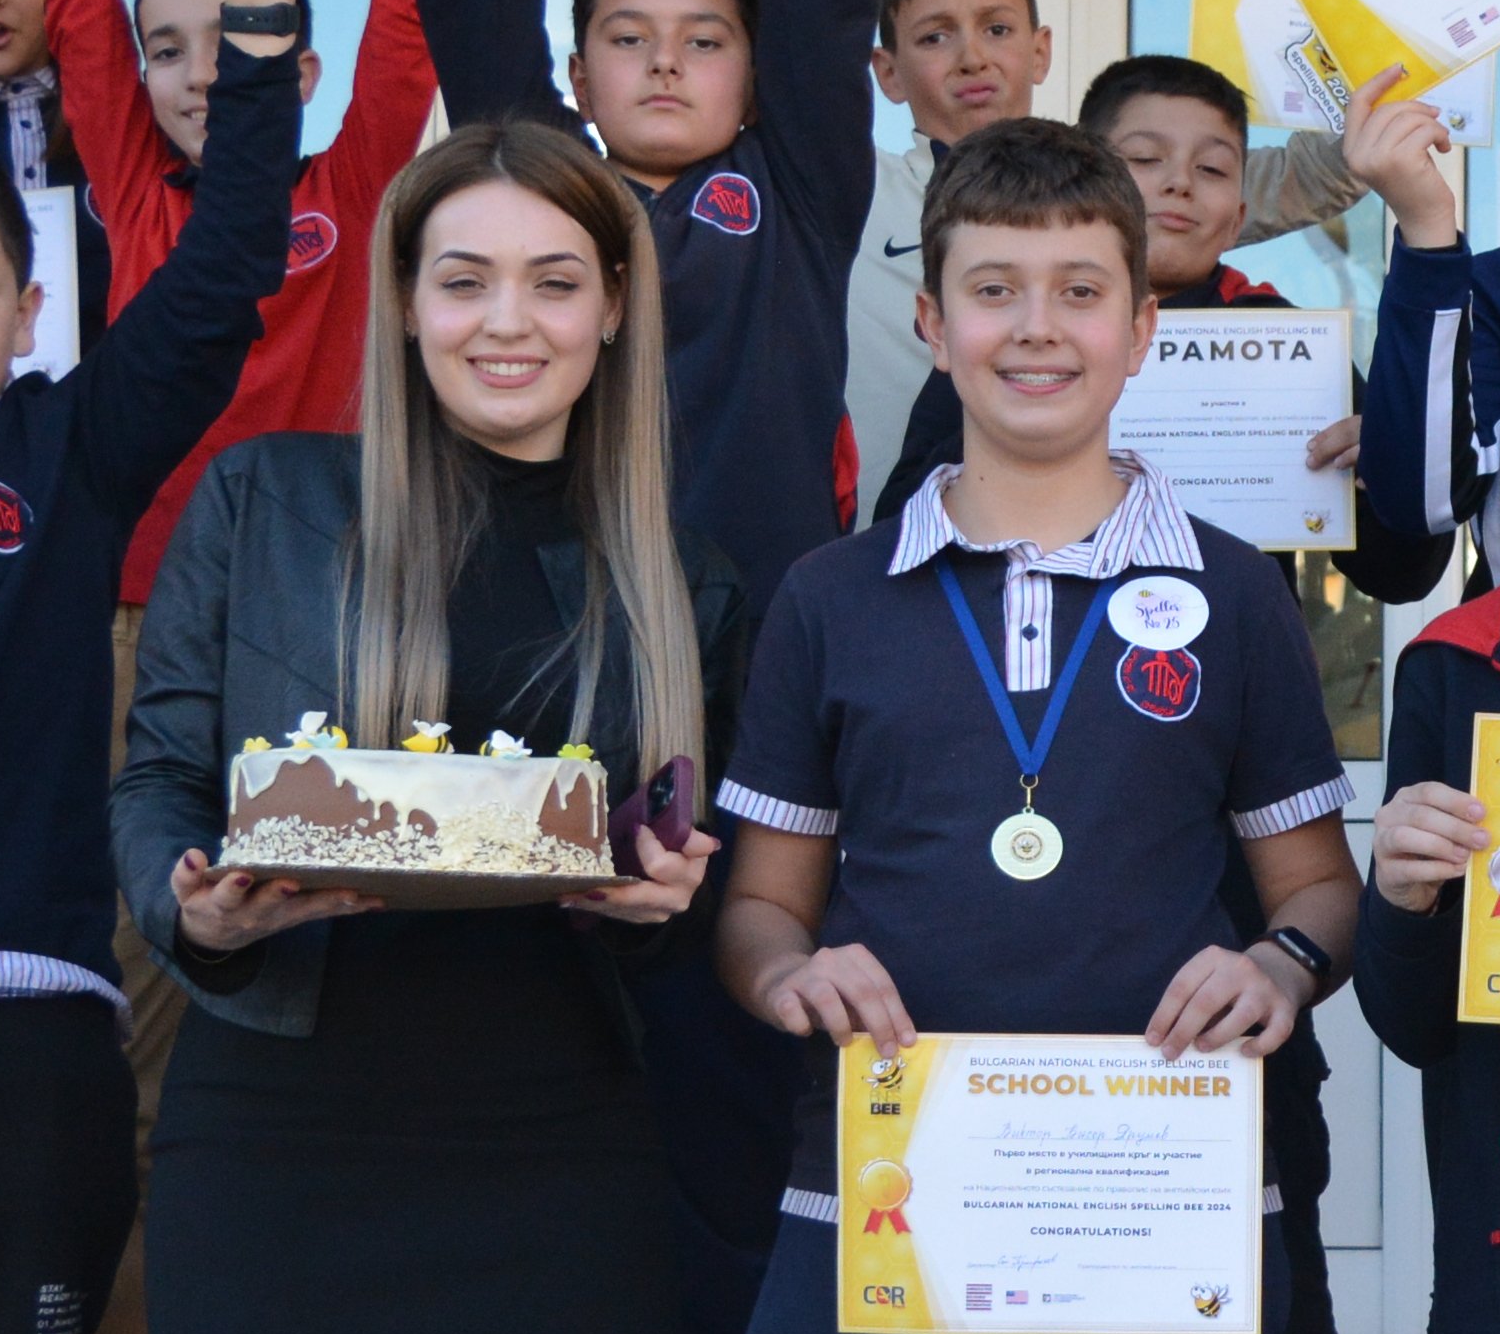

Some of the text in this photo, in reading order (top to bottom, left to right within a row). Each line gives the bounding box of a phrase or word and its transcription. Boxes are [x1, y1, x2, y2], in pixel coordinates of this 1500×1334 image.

[1150, 340, 1311, 362] РАМОТА
[1172, 477, 1274, 486] CONGRATULATIONS!
[969, 1057, 1230, 1070] BULGARIAN NATIONAL ENGLISH SPELLING BEE
[968, 1073, 1231, 1097] SCHOOL WINNER
[870, 1103, 900, 1115] BEE
[993, 1149, 1026, 1159] Първо
[1066, 1151, 1126, 1160] училищния
[1126, 1152, 1151, 1161] кръг
[1161, 1152, 1203, 1161] участие
[1026, 1166, 1170, 1179] в регионална квалификация
[963, 1200, 1232, 1212] BULGARIAN NATIONAL ENGLISH SPELLING BEE 2024
[1030, 1227, 1151, 1237] CONGRATULATIONS!
